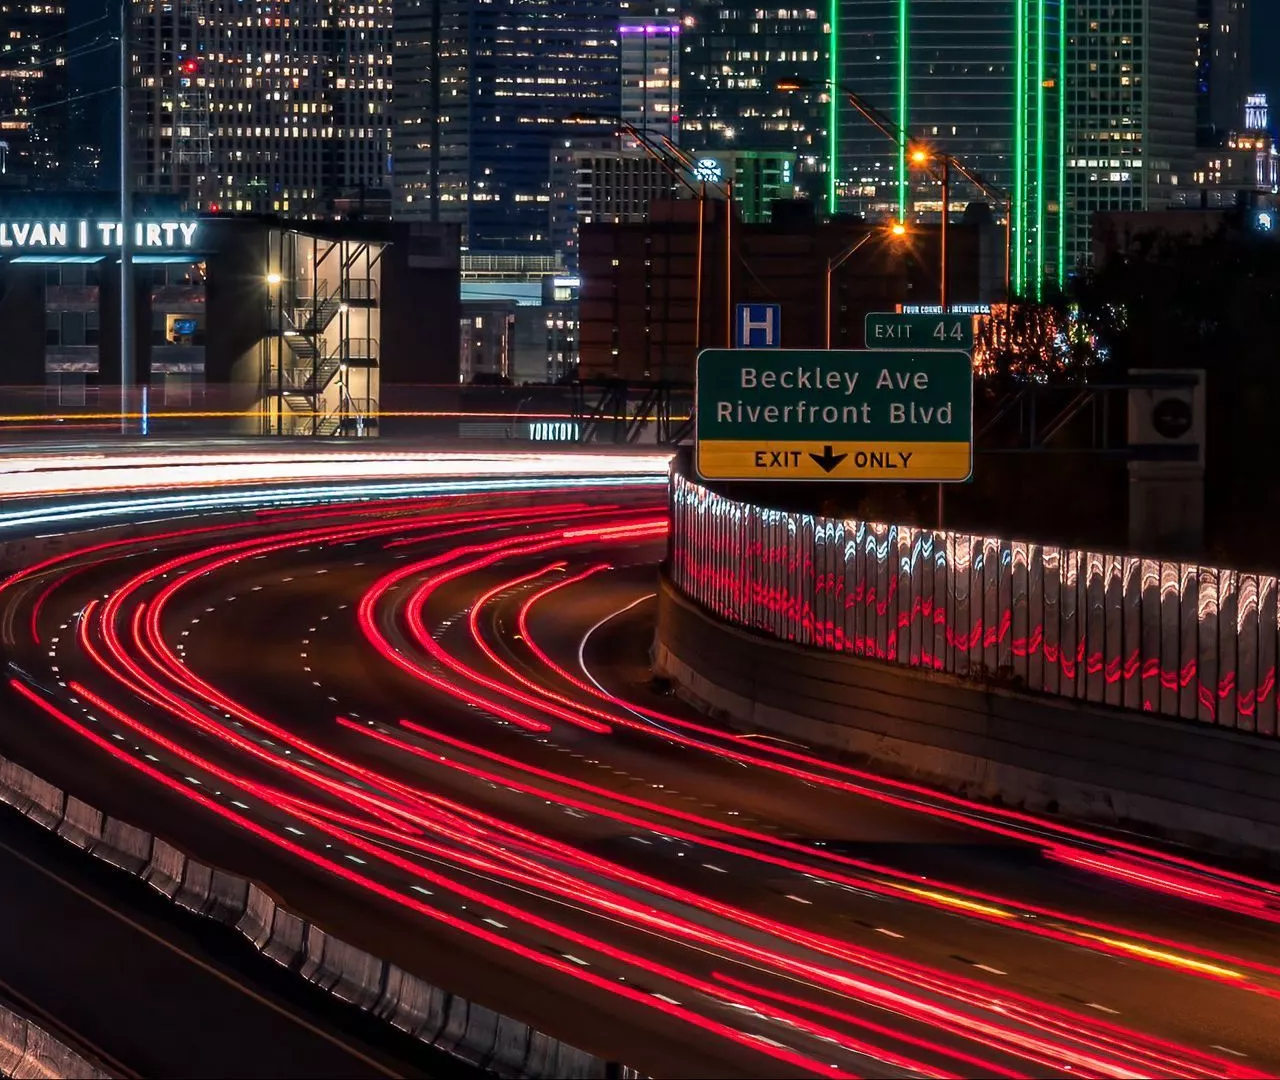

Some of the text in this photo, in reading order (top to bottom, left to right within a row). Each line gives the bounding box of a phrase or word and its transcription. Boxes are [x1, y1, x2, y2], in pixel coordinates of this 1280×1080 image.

[742, 306, 773, 346] H
[875, 321, 964, 341] EXIT 44
[741, 367, 929, 395] Beckley Ave
[717, 400, 953, 425] Riverfront Blvd
[529, 423, 579, 440] YORKTO
[754, 451, 913, 469] EXIT ONLY
